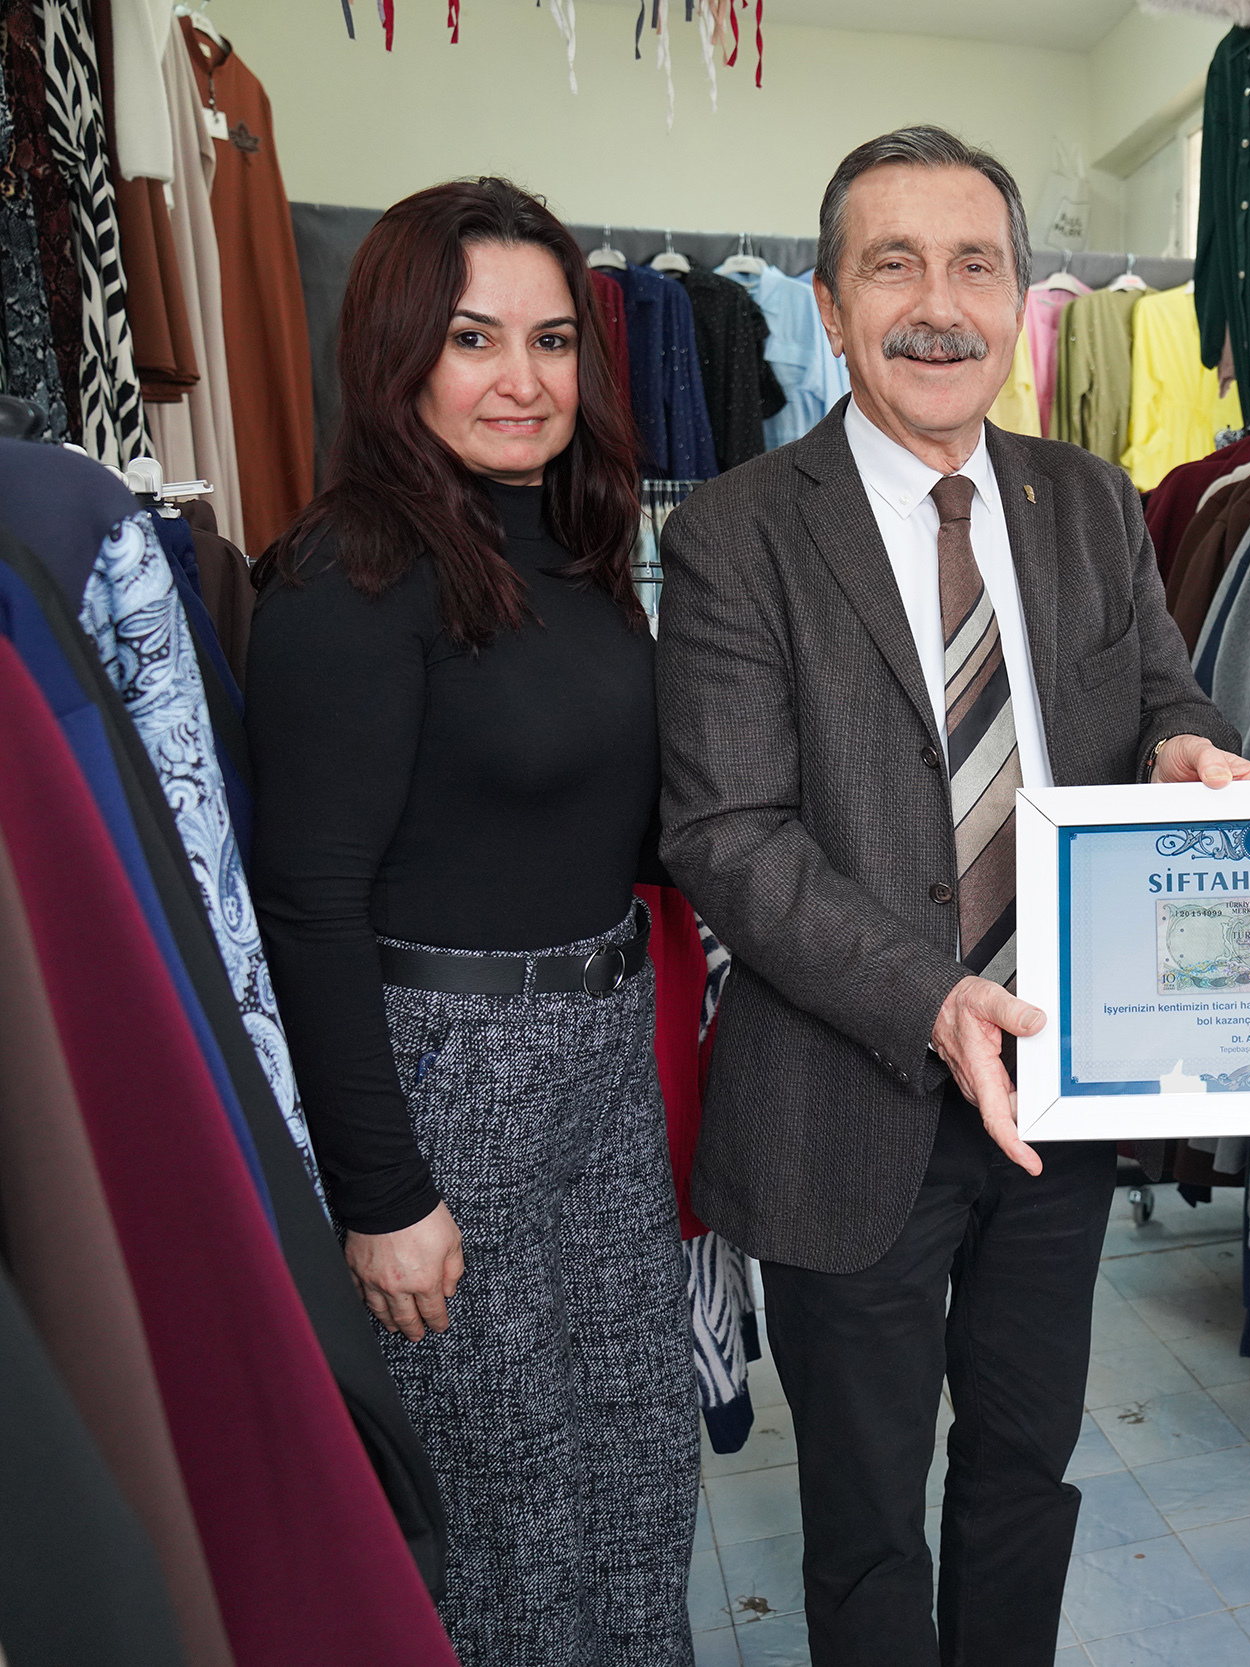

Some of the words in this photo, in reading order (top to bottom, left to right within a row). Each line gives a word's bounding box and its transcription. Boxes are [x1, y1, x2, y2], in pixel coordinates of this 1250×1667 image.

[1148, 867, 1250, 893] SİFTAH
[1162, 974, 1176, 984] 10
[1103, 1002, 1155, 1015] İşyerinizin
[1158, 1001, 1210, 1011] kentimizin
[1212, 1001, 1237, 1010] ticari
[1196, 1016, 1212, 1025] bol
[1231, 1035, 1244, 1043] Dt.
[1220, 1045, 1250, 1054] Tepebaşı
